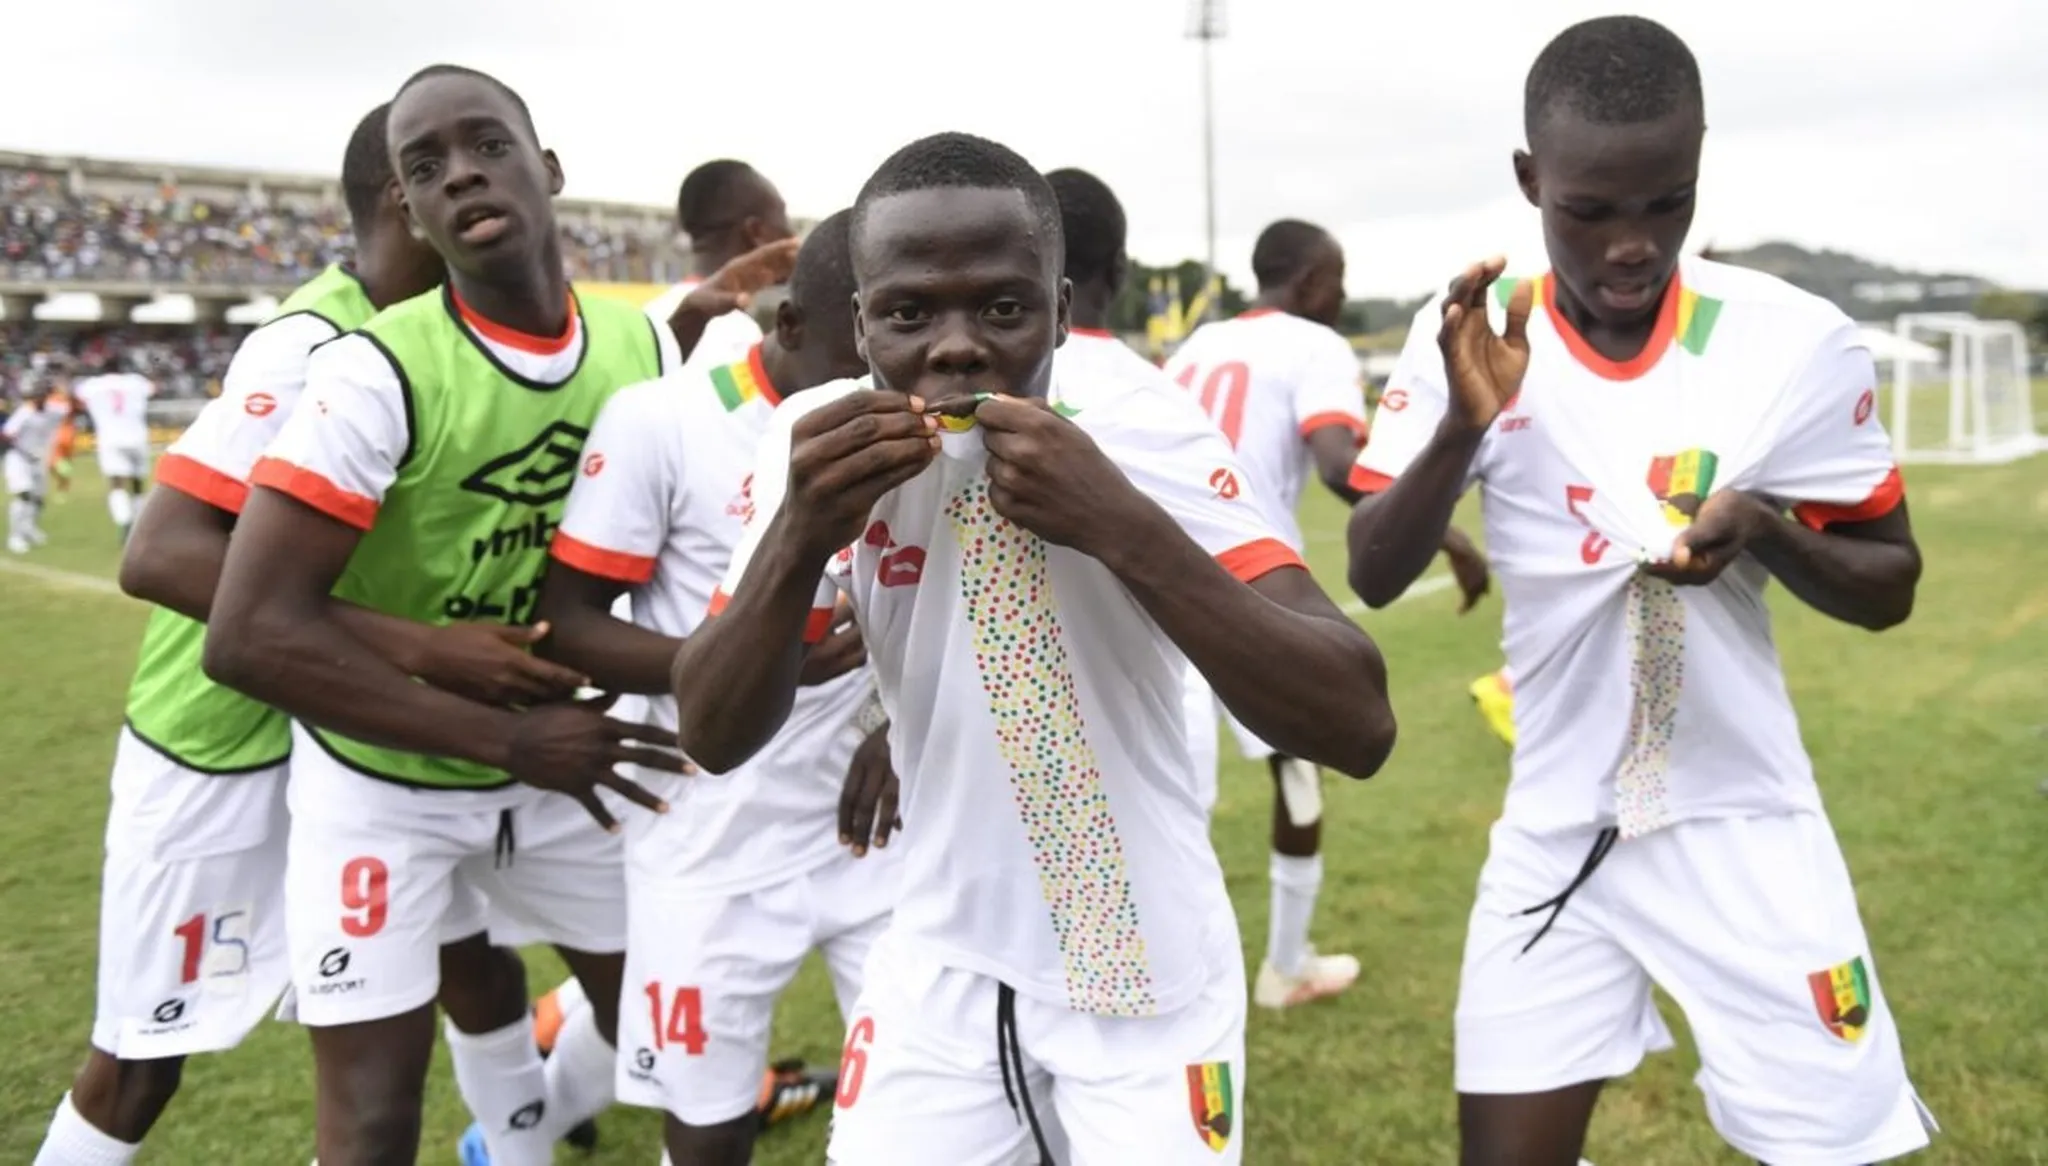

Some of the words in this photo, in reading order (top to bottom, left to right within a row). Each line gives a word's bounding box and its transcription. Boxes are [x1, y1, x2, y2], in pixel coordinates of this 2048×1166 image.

[341, 856, 388, 938] 9
[174, 911, 249, 985] 15
[645, 981, 708, 1055] 14
[836, 1016, 874, 1108] 6
